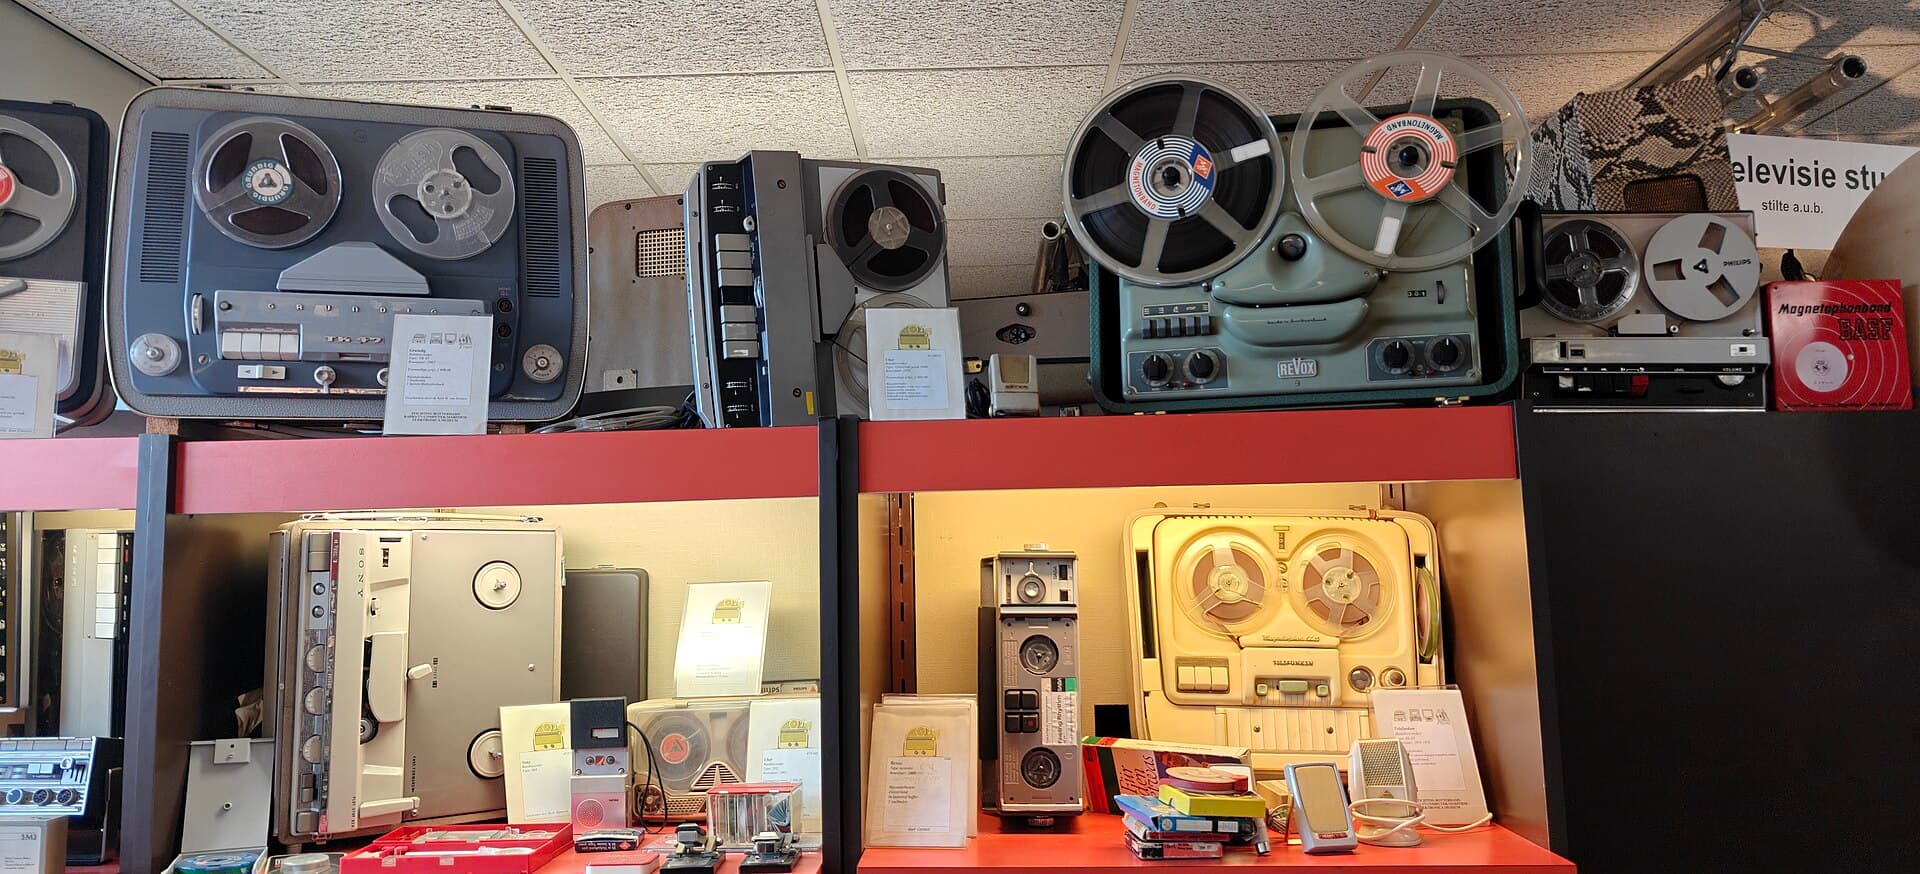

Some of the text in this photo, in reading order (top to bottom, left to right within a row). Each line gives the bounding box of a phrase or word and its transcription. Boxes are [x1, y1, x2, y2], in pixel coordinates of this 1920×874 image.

[1386, 119, 1444, 140] MAGNETONBAND
[246, 162, 274, 189] GRUNDIG
[1132, 161, 1156, 210] MAGNETONBAND
[1761, 199, 1824, 214] stilte a.u.b.
[1723, 258, 1751, 267] PHILIPS
[1778, 303, 1892, 317] Magnetophonband
[1837, 318, 1894, 341] BASF
[357, 547, 365, 598] SONY
